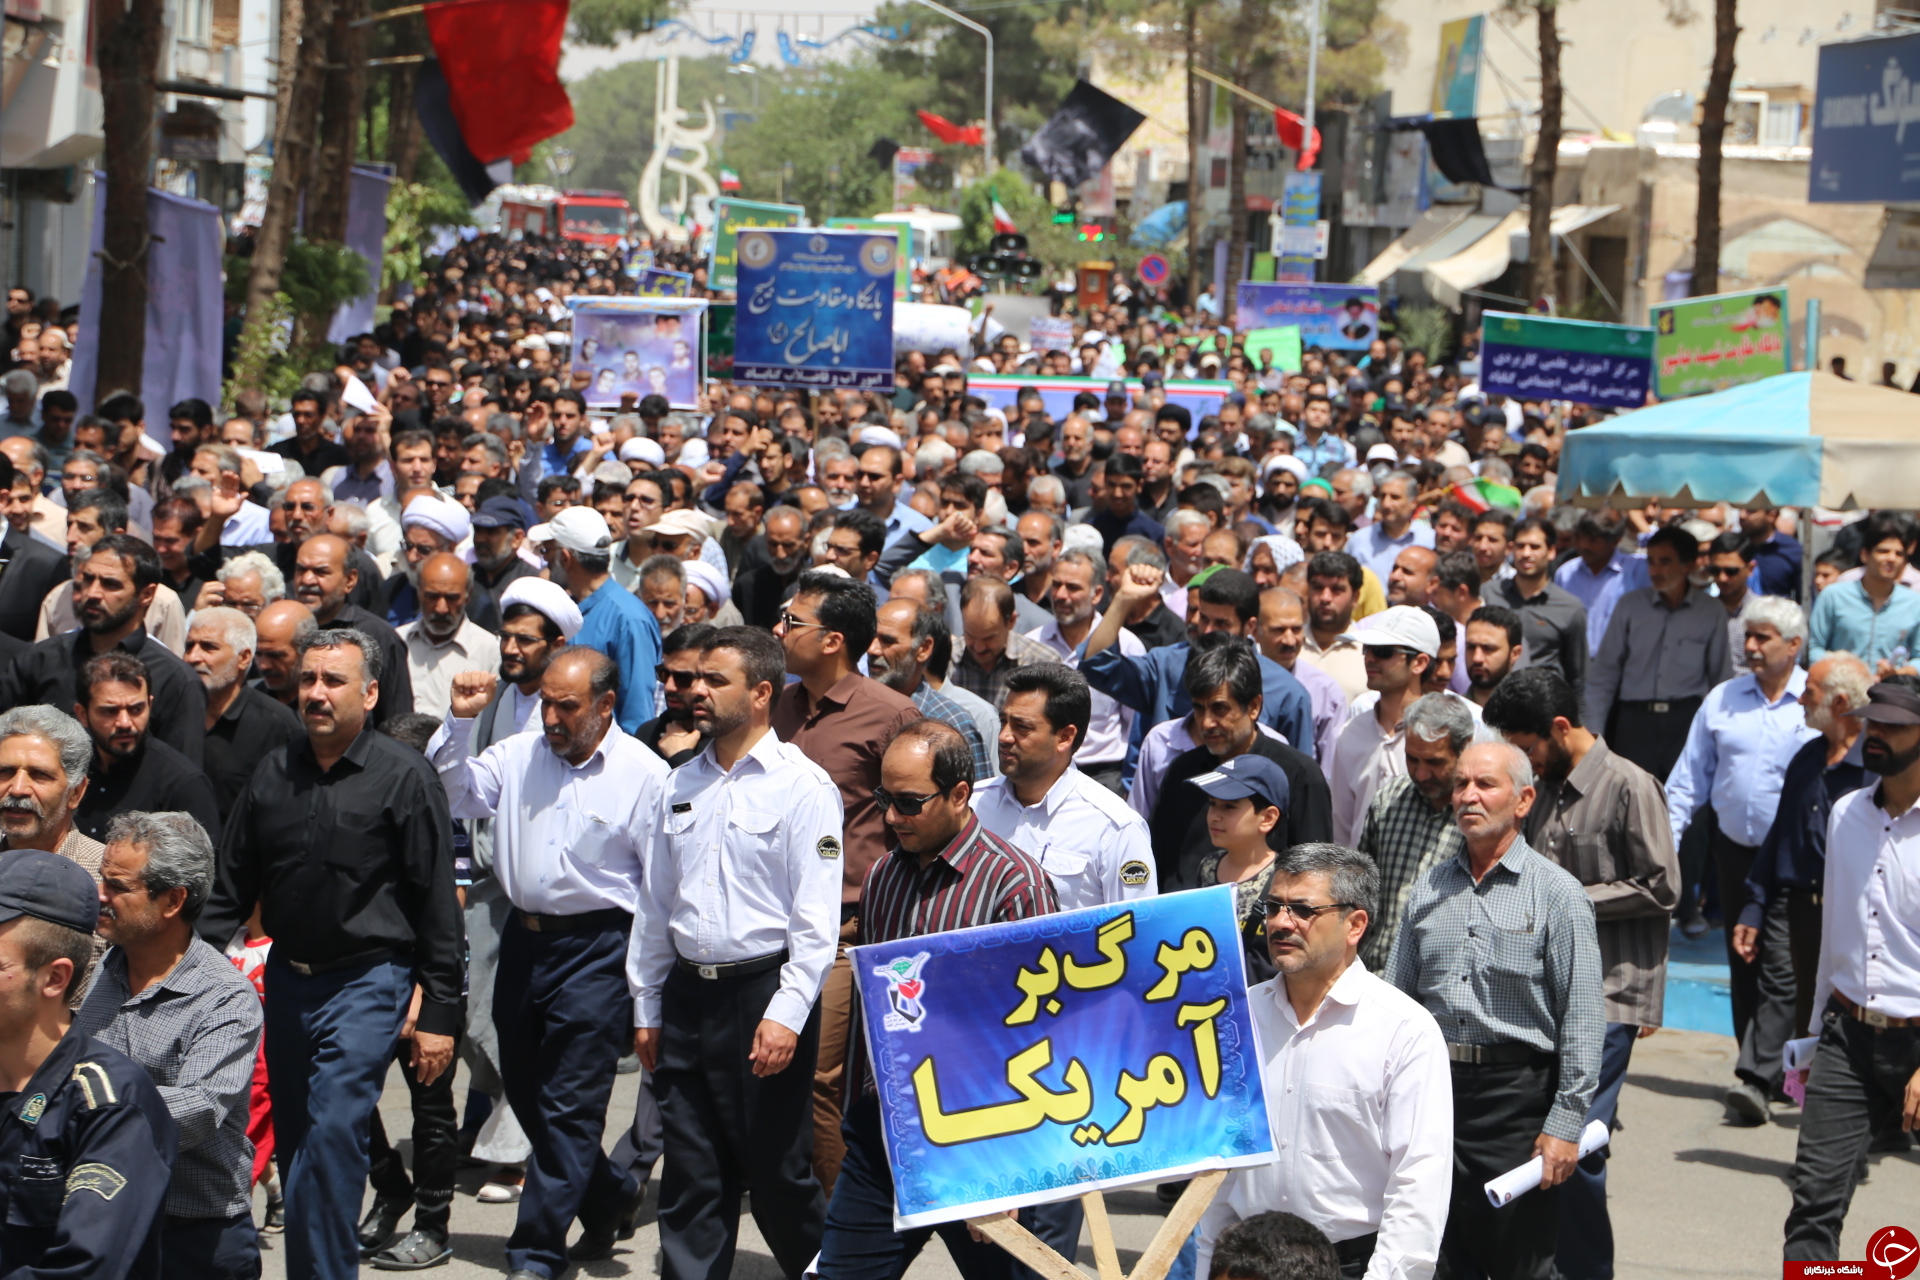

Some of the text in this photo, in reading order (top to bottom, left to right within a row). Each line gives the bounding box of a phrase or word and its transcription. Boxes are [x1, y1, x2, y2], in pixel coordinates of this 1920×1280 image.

[776, 286, 846, 309] مقاومت
[845, 280, 883, 319] پایگاه
[783, 369, 830, 383] فاضلاب
[1568, 356, 1611, 376] آموزش
[831, 374, 839, 387] و
[839, 370, 857, 385] آب
[860, 373, 883, 388] امور
[1003, 943, 1064, 1027] بر
[911, 996, 1228, 1148] آمریکا
